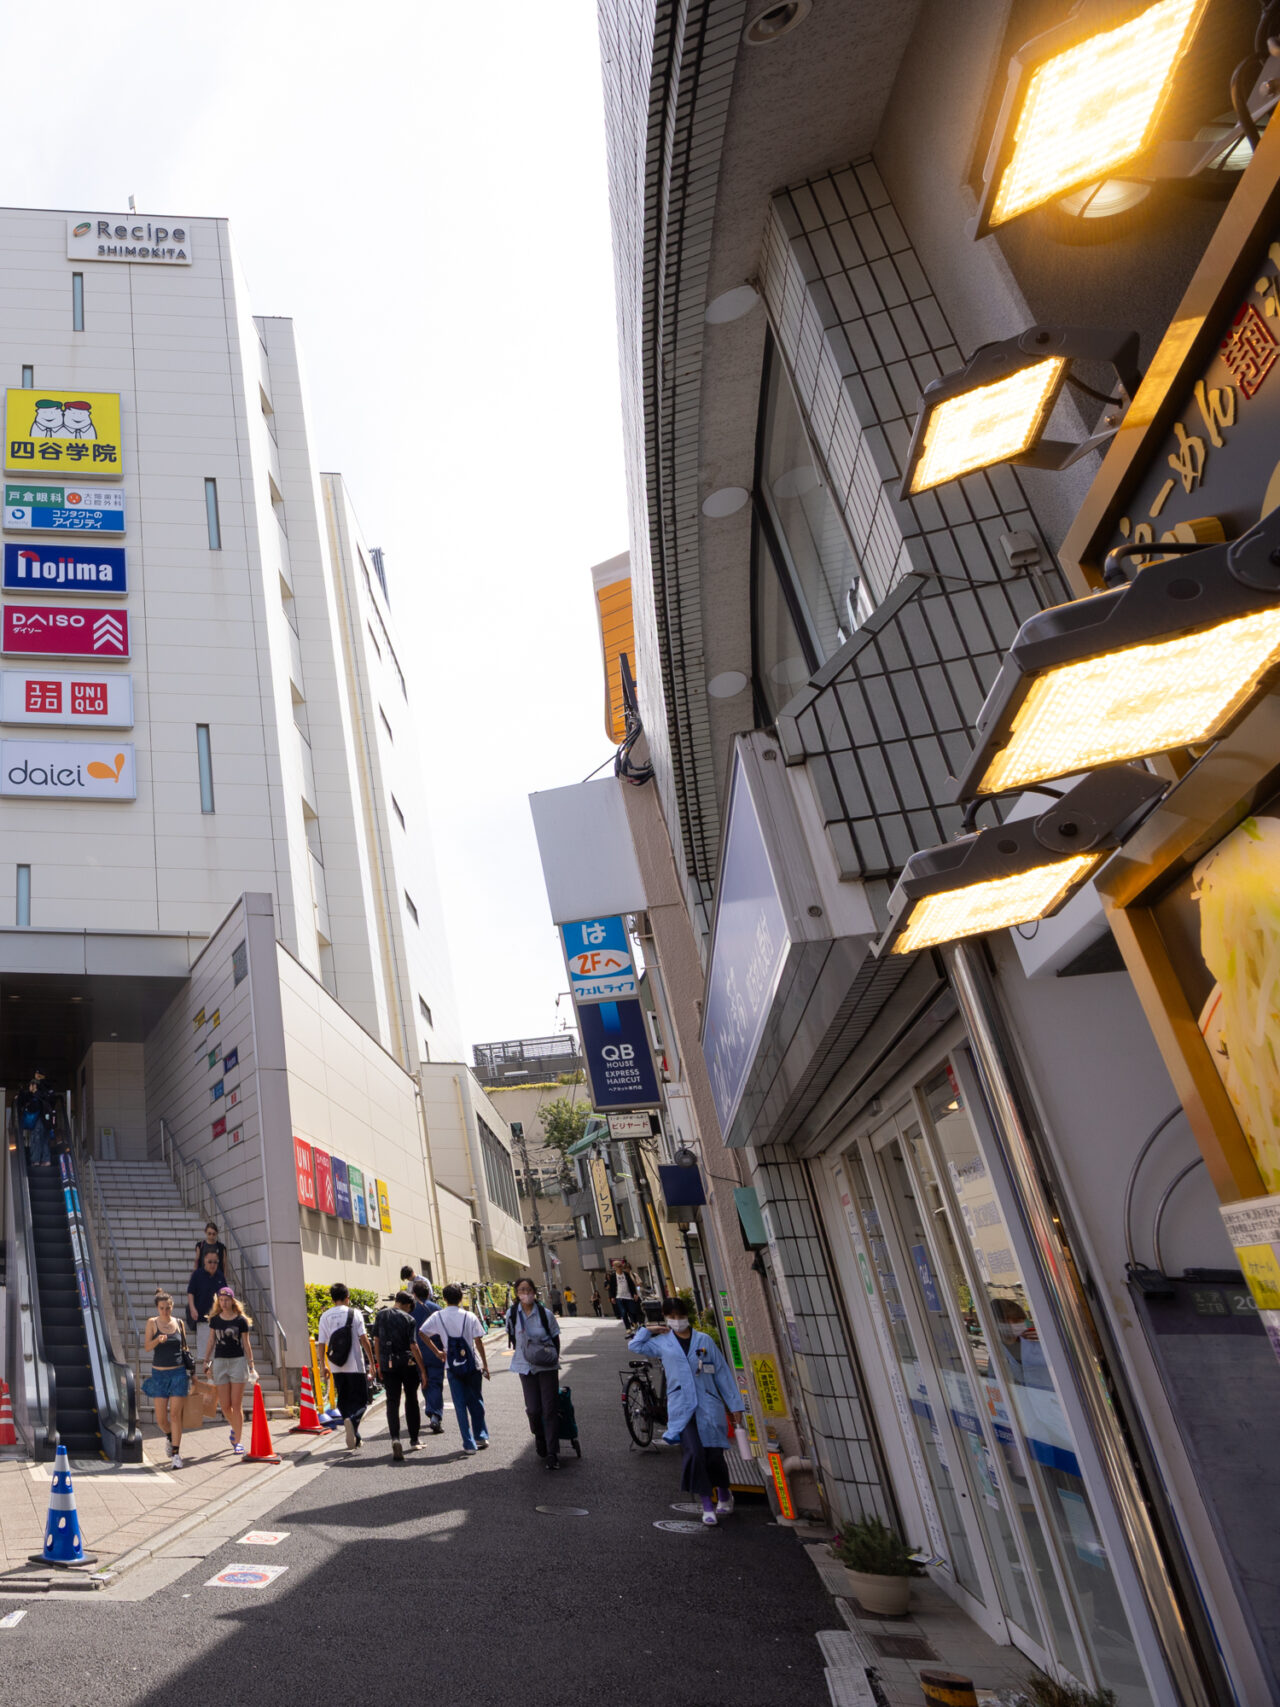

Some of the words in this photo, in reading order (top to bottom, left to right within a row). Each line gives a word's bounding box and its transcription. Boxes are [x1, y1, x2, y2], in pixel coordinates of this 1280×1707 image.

[97, 221, 186, 245] Recipe
[98, 245, 187, 260] SHIMOKITA
[10, 440, 118, 463] 四谷学院
[8, 491, 63, 504] 戸倉眼科
[52, 510, 103, 519] コンタクトの
[52, 518, 103, 529] アイシティ
[17, 550, 113, 583] nojima
[12, 613, 86, 627] DAISO
[30, 684, 57, 696] ユニ
[75, 686, 101, 698] UNI
[29, 698, 58, 710] クロ
[75, 699, 104, 712] QLO
[8, 759, 86, 787] daiei
[581, 922, 607, 945] は
[575, 981, 636, 997] ウェルライフ
[601, 1043, 635, 1061] QB
[606, 1060, 634, 1068] HOUSE
[605, 1068, 640, 1078] EXPRESS
[606, 1076, 641, 1085] HAIRCUT
[612, 1122, 649, 1130] ビリヤード
[296, 1145, 310, 1172] UNI
[299, 1174, 313, 1201] QLO
